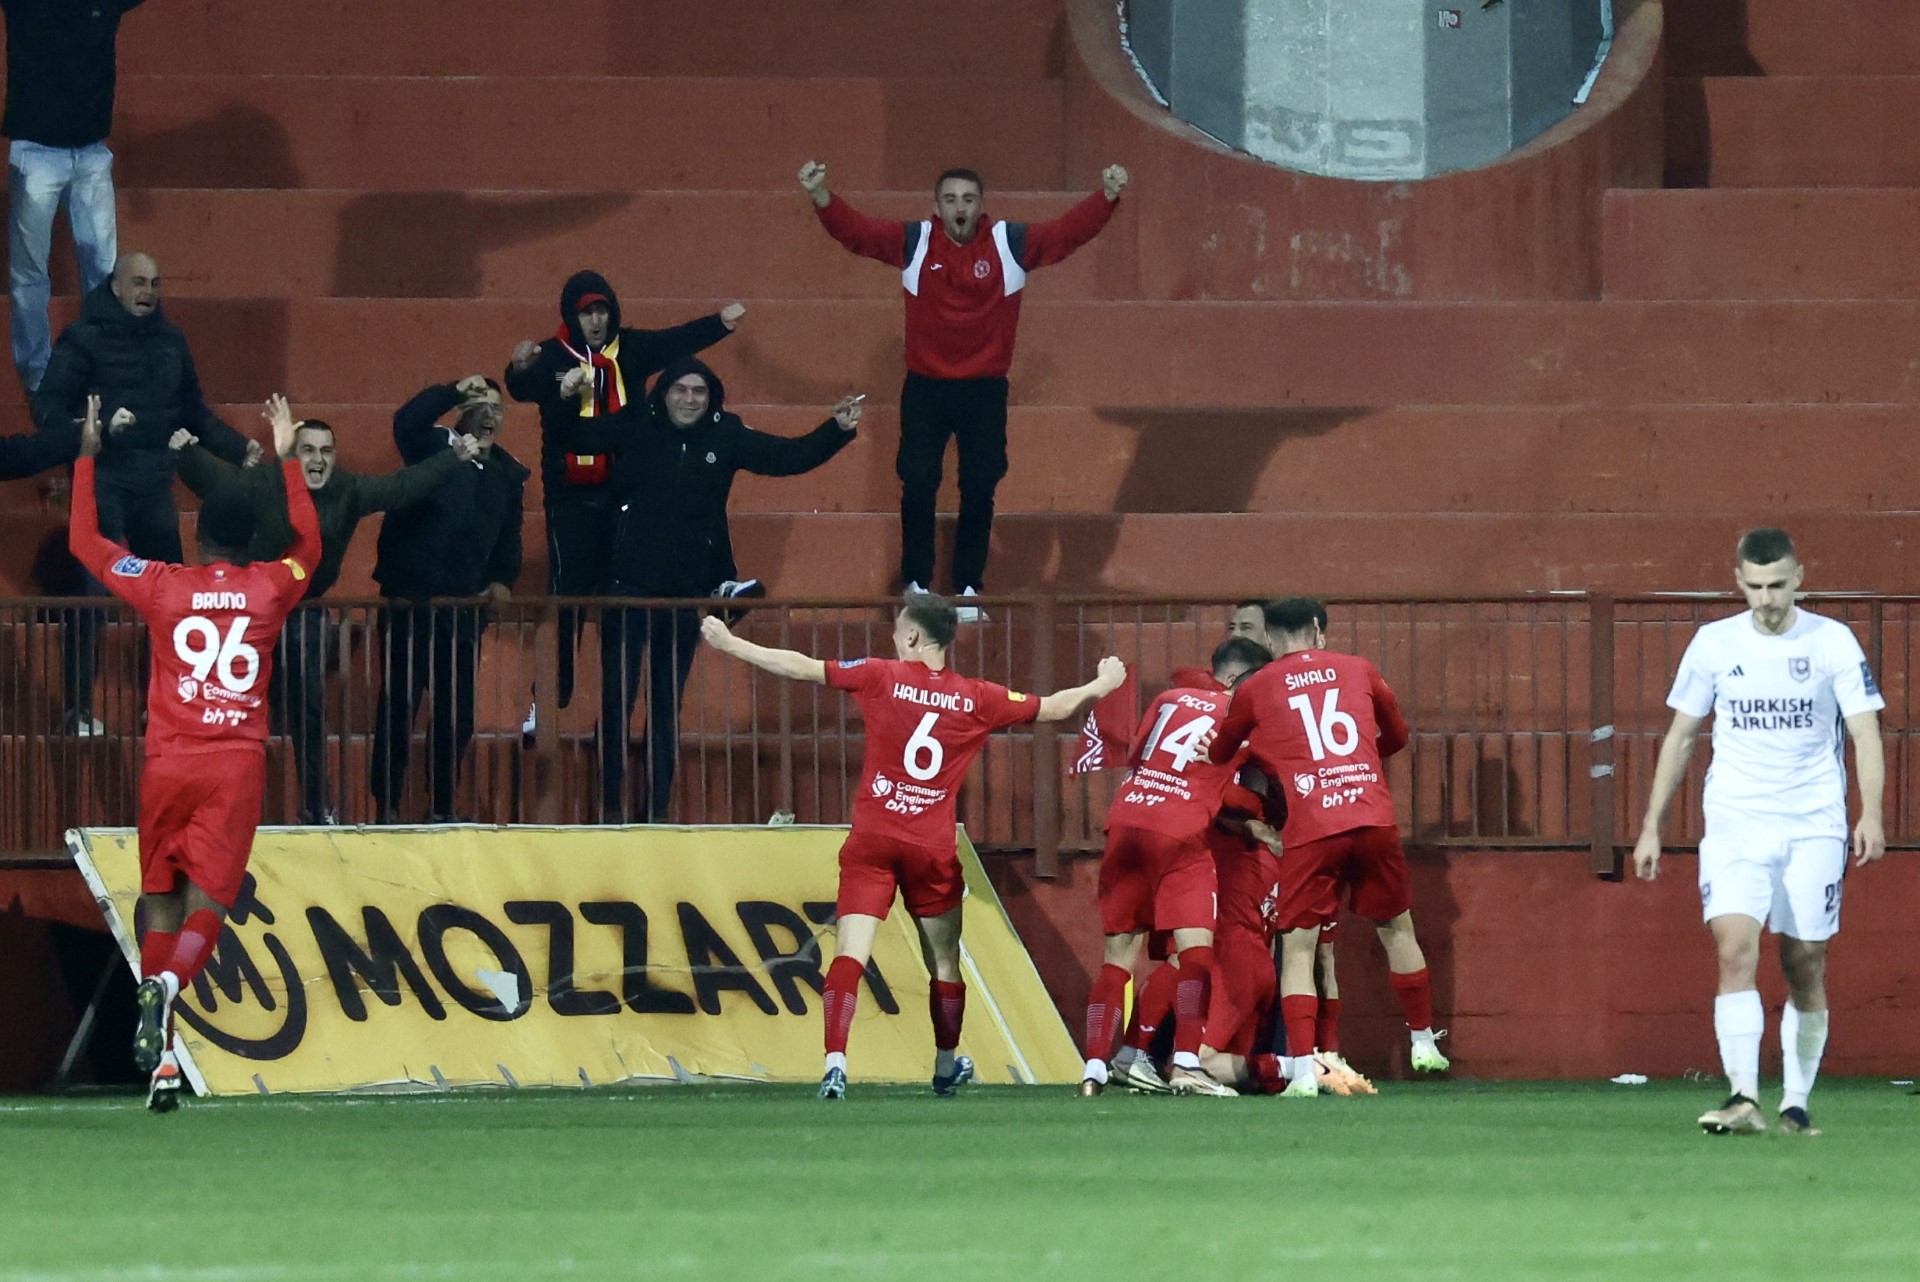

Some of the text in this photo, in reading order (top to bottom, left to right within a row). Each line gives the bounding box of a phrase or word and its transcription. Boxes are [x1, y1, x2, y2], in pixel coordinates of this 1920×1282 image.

[192, 591, 247, 610] BRUNO
[173, 615, 260, 693] 96
[1285, 668, 1337, 691] ŠIKALO
[893, 682, 974, 713] HALILOVIĆ D
[1176, 694, 1217, 712] PECO
[1728, 698, 1813, 714] TURKISH
[1288, 687, 1359, 762] 16
[1731, 713, 1814, 730] AIRLINES
[903, 711, 944, 781] 6
[1140, 703, 1216, 773] 14
[1137, 765, 1188, 788] Commerce
[1318, 763, 1370, 778] Commerce
[1320, 772, 1378, 789] Engineering
[1134, 775, 1192, 801] Engineering
